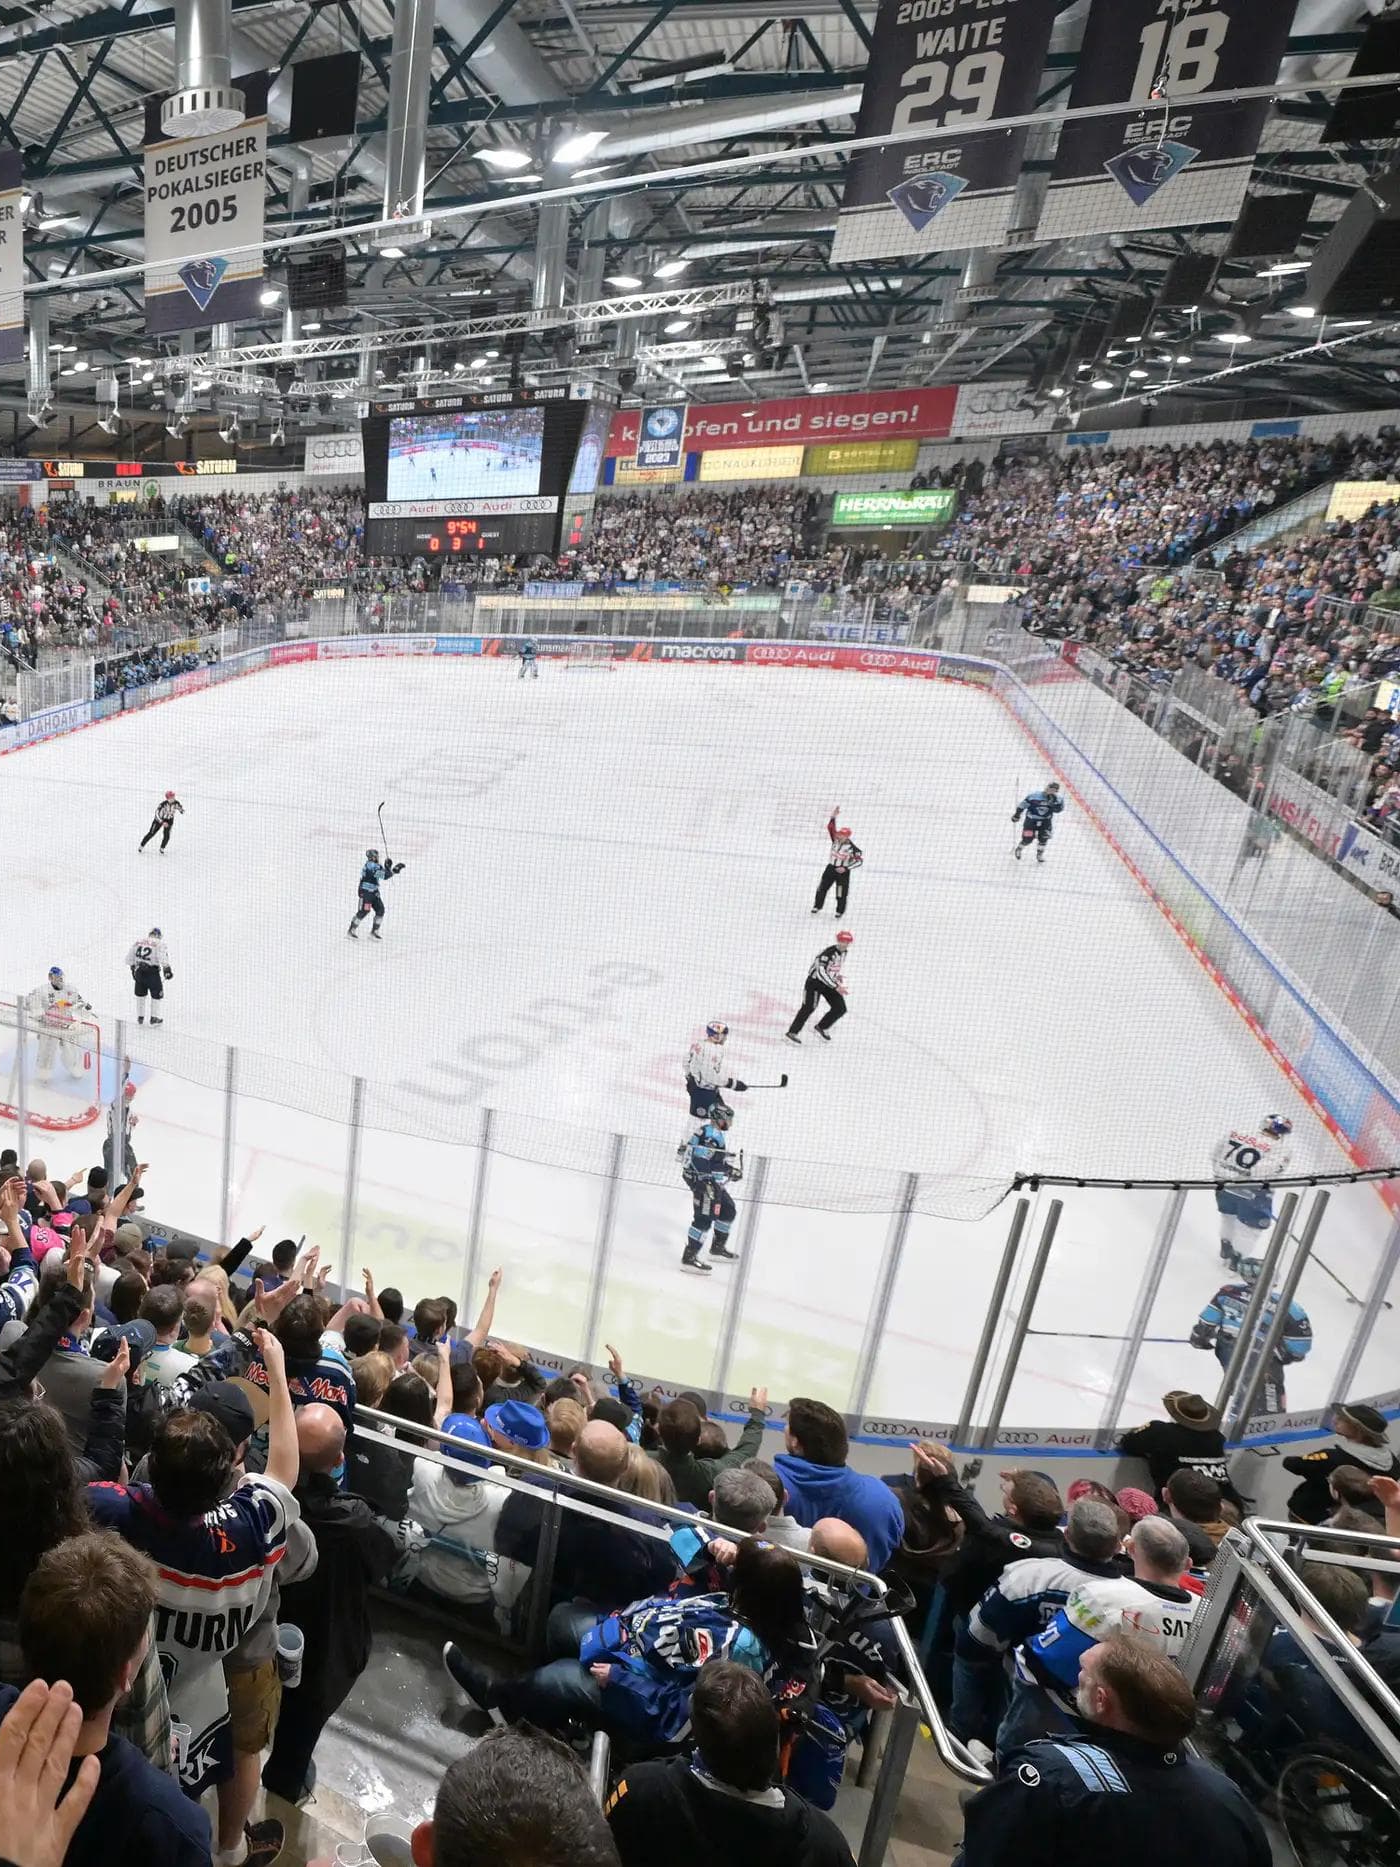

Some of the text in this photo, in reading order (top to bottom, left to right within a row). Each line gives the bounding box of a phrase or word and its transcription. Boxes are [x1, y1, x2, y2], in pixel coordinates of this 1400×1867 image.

[916, 17, 1008, 59] WAITE
[1130, 10, 1231, 101] 18
[891, 50, 1006, 136] 29
[1124, 115, 1193, 139] ERC
[155, 136, 258, 177] DEUTSCHER
[903, 148, 963, 171] ERC
[147, 161, 265, 203] POKALSIEGER
[170, 195, 239, 234] 2005
[483, 393, 513, 404] SATURN
[534, 388, 566, 400] SATURN
[387, 401, 416, 413] SATURN
[435, 397, 463, 409] SATURN
[748, 413, 802, 433] und
[809, 404, 920, 431] siegen!
[644, 452, 671, 463] 2023
[197, 459, 238, 475] SATURN
[98, 480, 141, 489] BRAUN
[408, 500, 514, 514] Audi Audi
[430, 538, 440, 551] 0
[452, 537, 462, 550] 3
[313, 588, 345, 600] SATURN
[661, 643, 736, 661] macron
[794, 648, 836, 662] Audi
[899, 656, 938, 671] Audi
[135, 945, 153, 961] 42
[1224, 1139, 1261, 1170] 70
[525, 1350, 566, 1373] Audi
[1283, 1415, 1319, 1430] Audi
[904, 1426, 956, 1441] Audi
[1045, 1433, 1093, 1447] Audi
